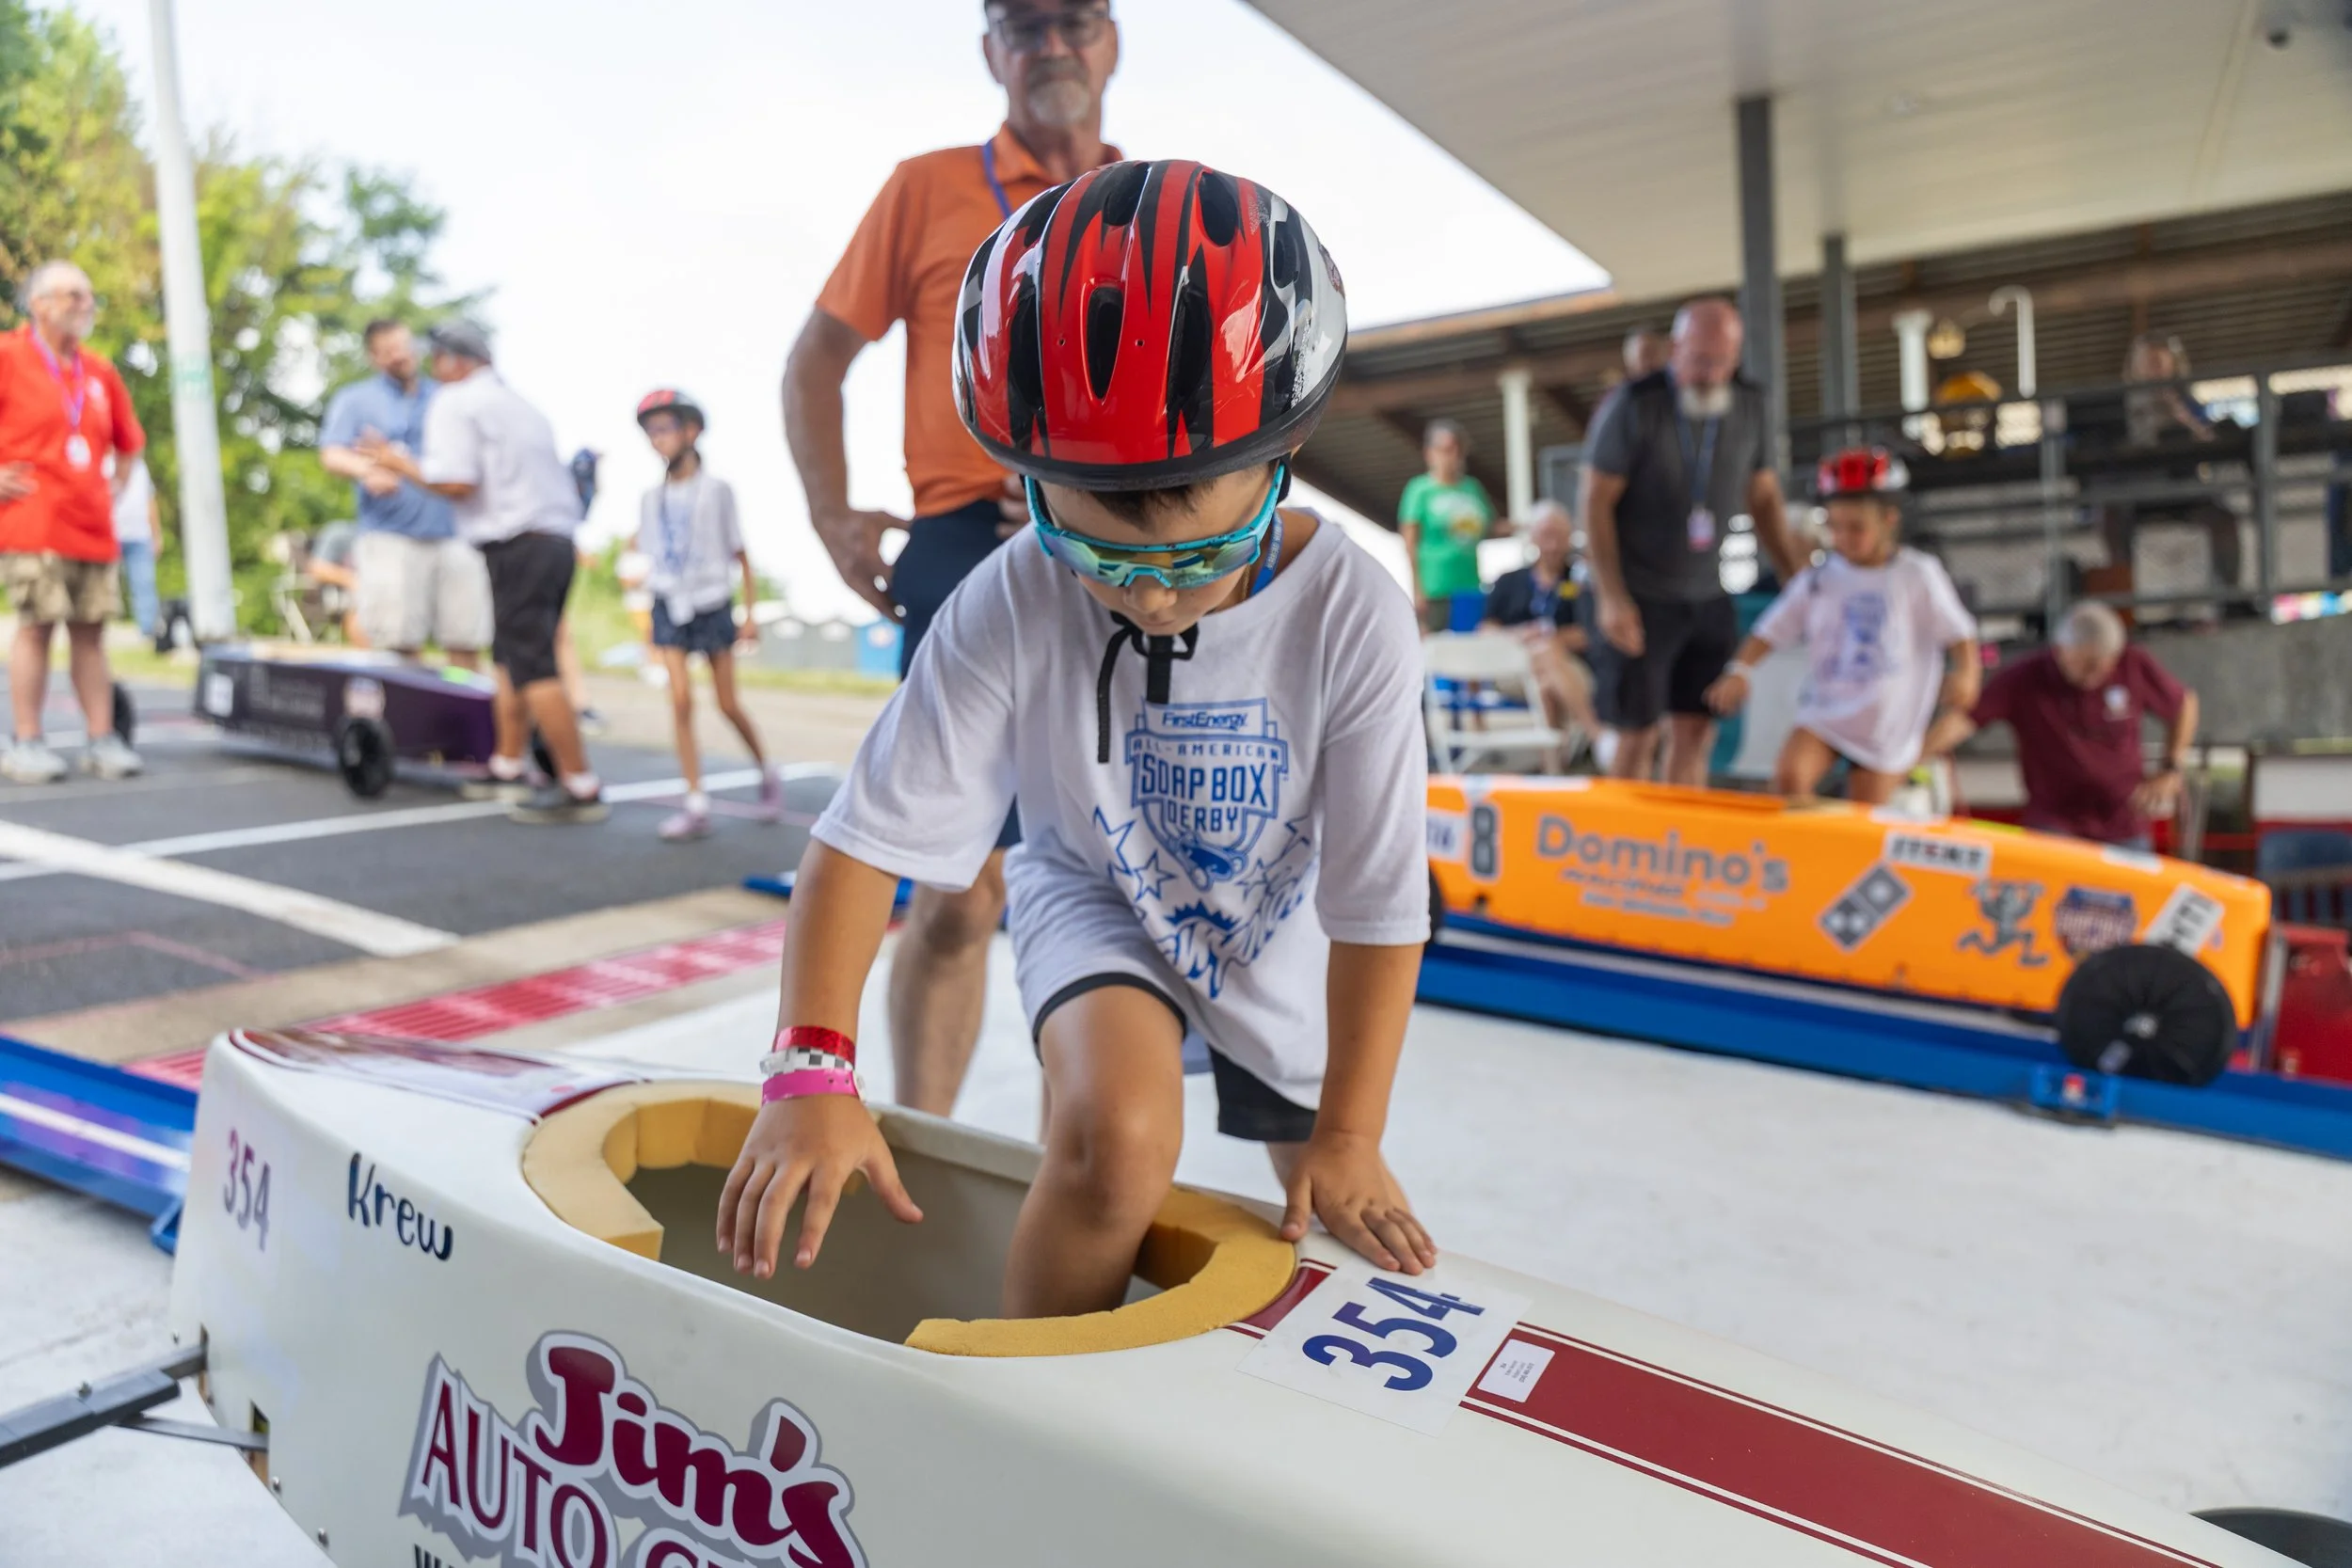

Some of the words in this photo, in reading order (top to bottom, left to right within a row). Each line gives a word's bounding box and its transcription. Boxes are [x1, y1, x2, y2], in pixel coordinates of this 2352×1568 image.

[1162, 711, 1248, 732] FirstEnergy
[1141, 752, 1205, 800] SOAP
[1211, 763, 1267, 807] BOX
[1167, 800, 1239, 832] DERBY
[1536, 816, 1789, 893] Domino's
[223, 1126, 271, 1252] 354
[347, 1151, 453, 1261] Krew
[1302, 1276, 1486, 1391] 354
[421, 1378, 608, 1568] AUTO
[535, 1346, 853, 1568] Jim's
